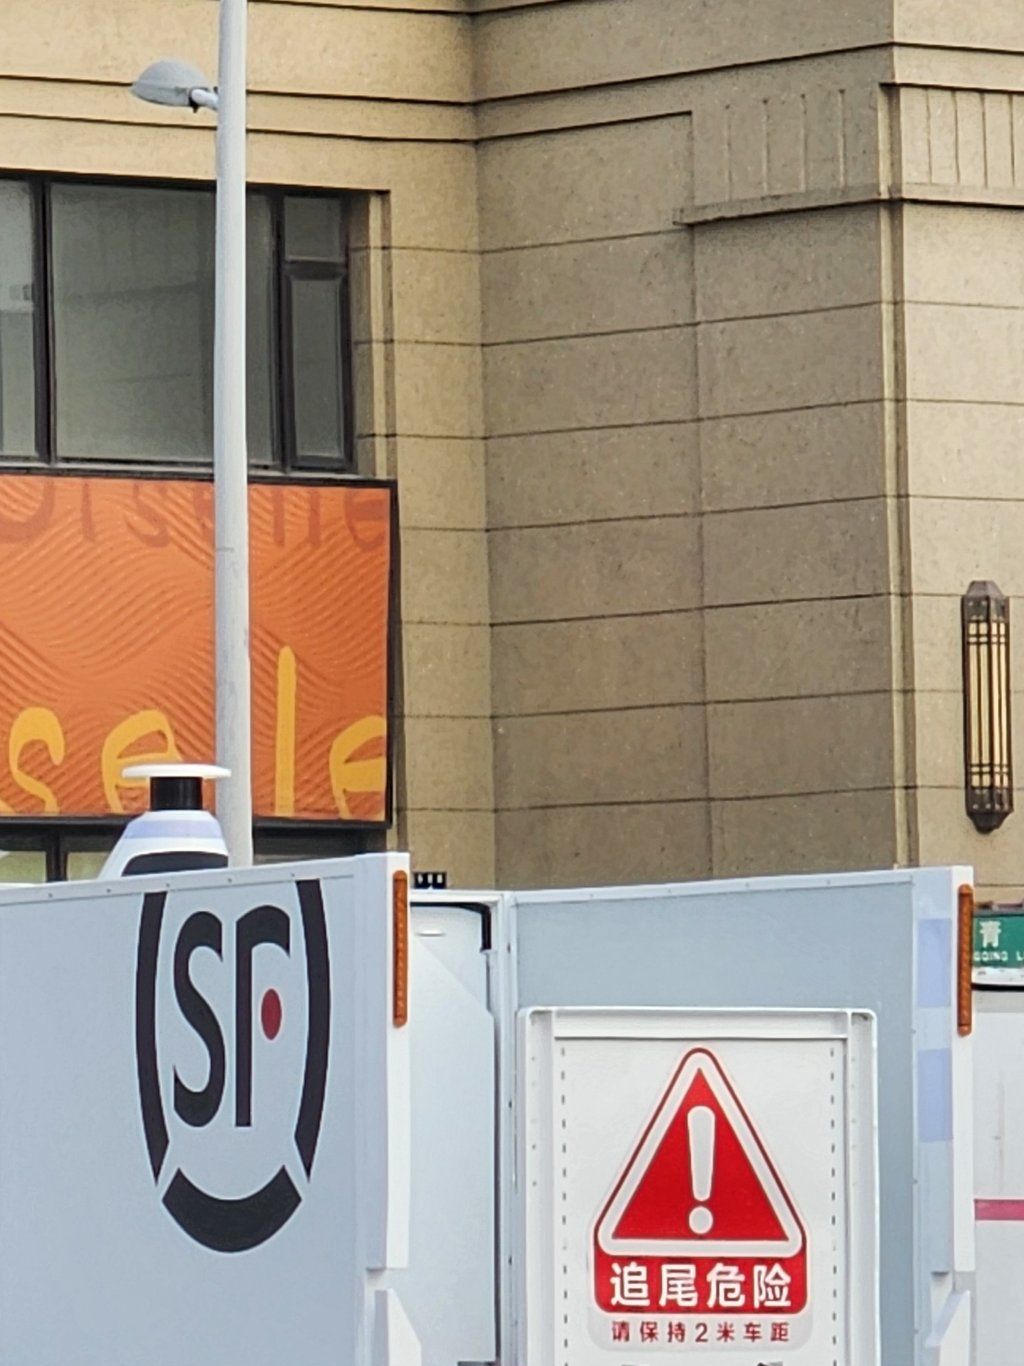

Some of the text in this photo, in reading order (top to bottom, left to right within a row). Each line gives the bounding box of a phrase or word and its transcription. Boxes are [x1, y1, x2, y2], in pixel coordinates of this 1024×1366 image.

[172, 904, 292, 1128] SF
[609, 1261, 792, 1309] 追尾危险
[611, 1321, 790, 1343] 请保持2米车距
